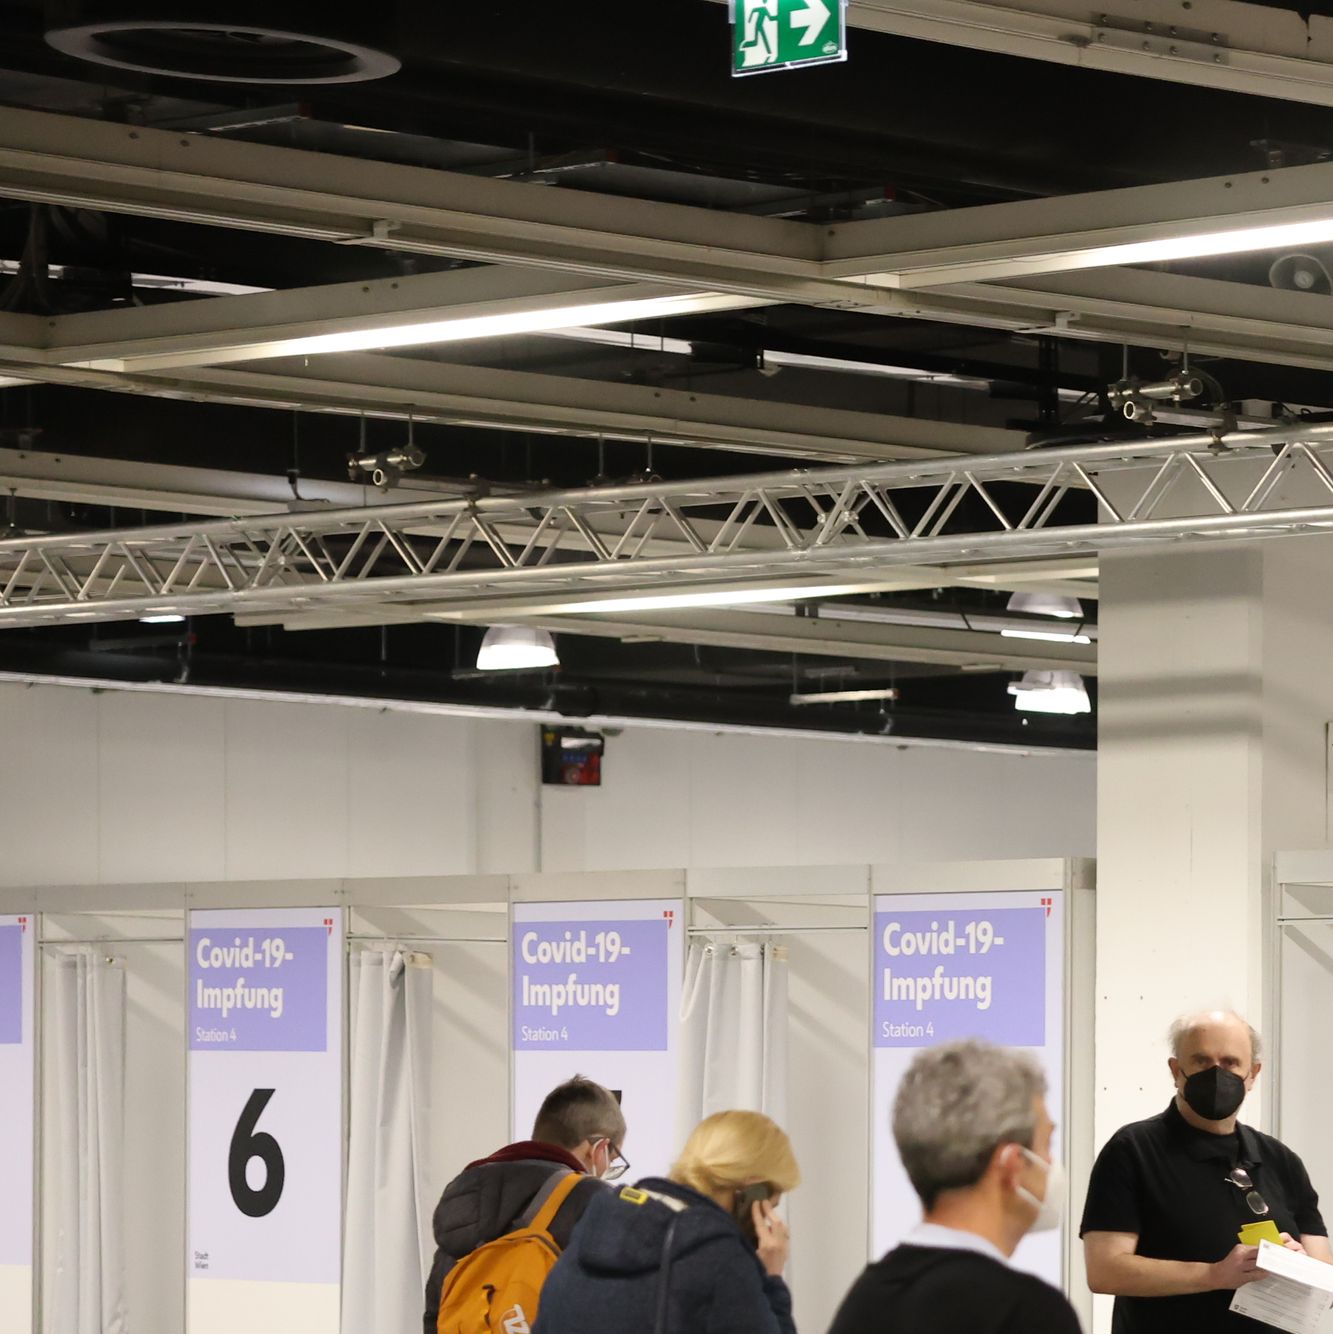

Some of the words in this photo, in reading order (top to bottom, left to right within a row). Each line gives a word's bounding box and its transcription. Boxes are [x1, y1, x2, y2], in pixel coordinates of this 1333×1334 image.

[196, 937, 294, 969] Covid-19-
[521, 930, 631, 965] Covid-19-
[883, 920, 1005, 957] Covid-19-
[196, 977, 284, 1019] Impfung
[522, 973, 620, 1016] Impfung
[883, 965, 992, 1011] Impfung
[195, 1026, 229, 1042] Station
[229, 1027, 238, 1042] 4
[521, 1025, 559, 1042] Station
[560, 1026, 569, 1041] 4
[882, 1021, 922, 1038] Station
[925, 1021, 935, 1037] 4
[228, 1088, 286, 1218] 6
